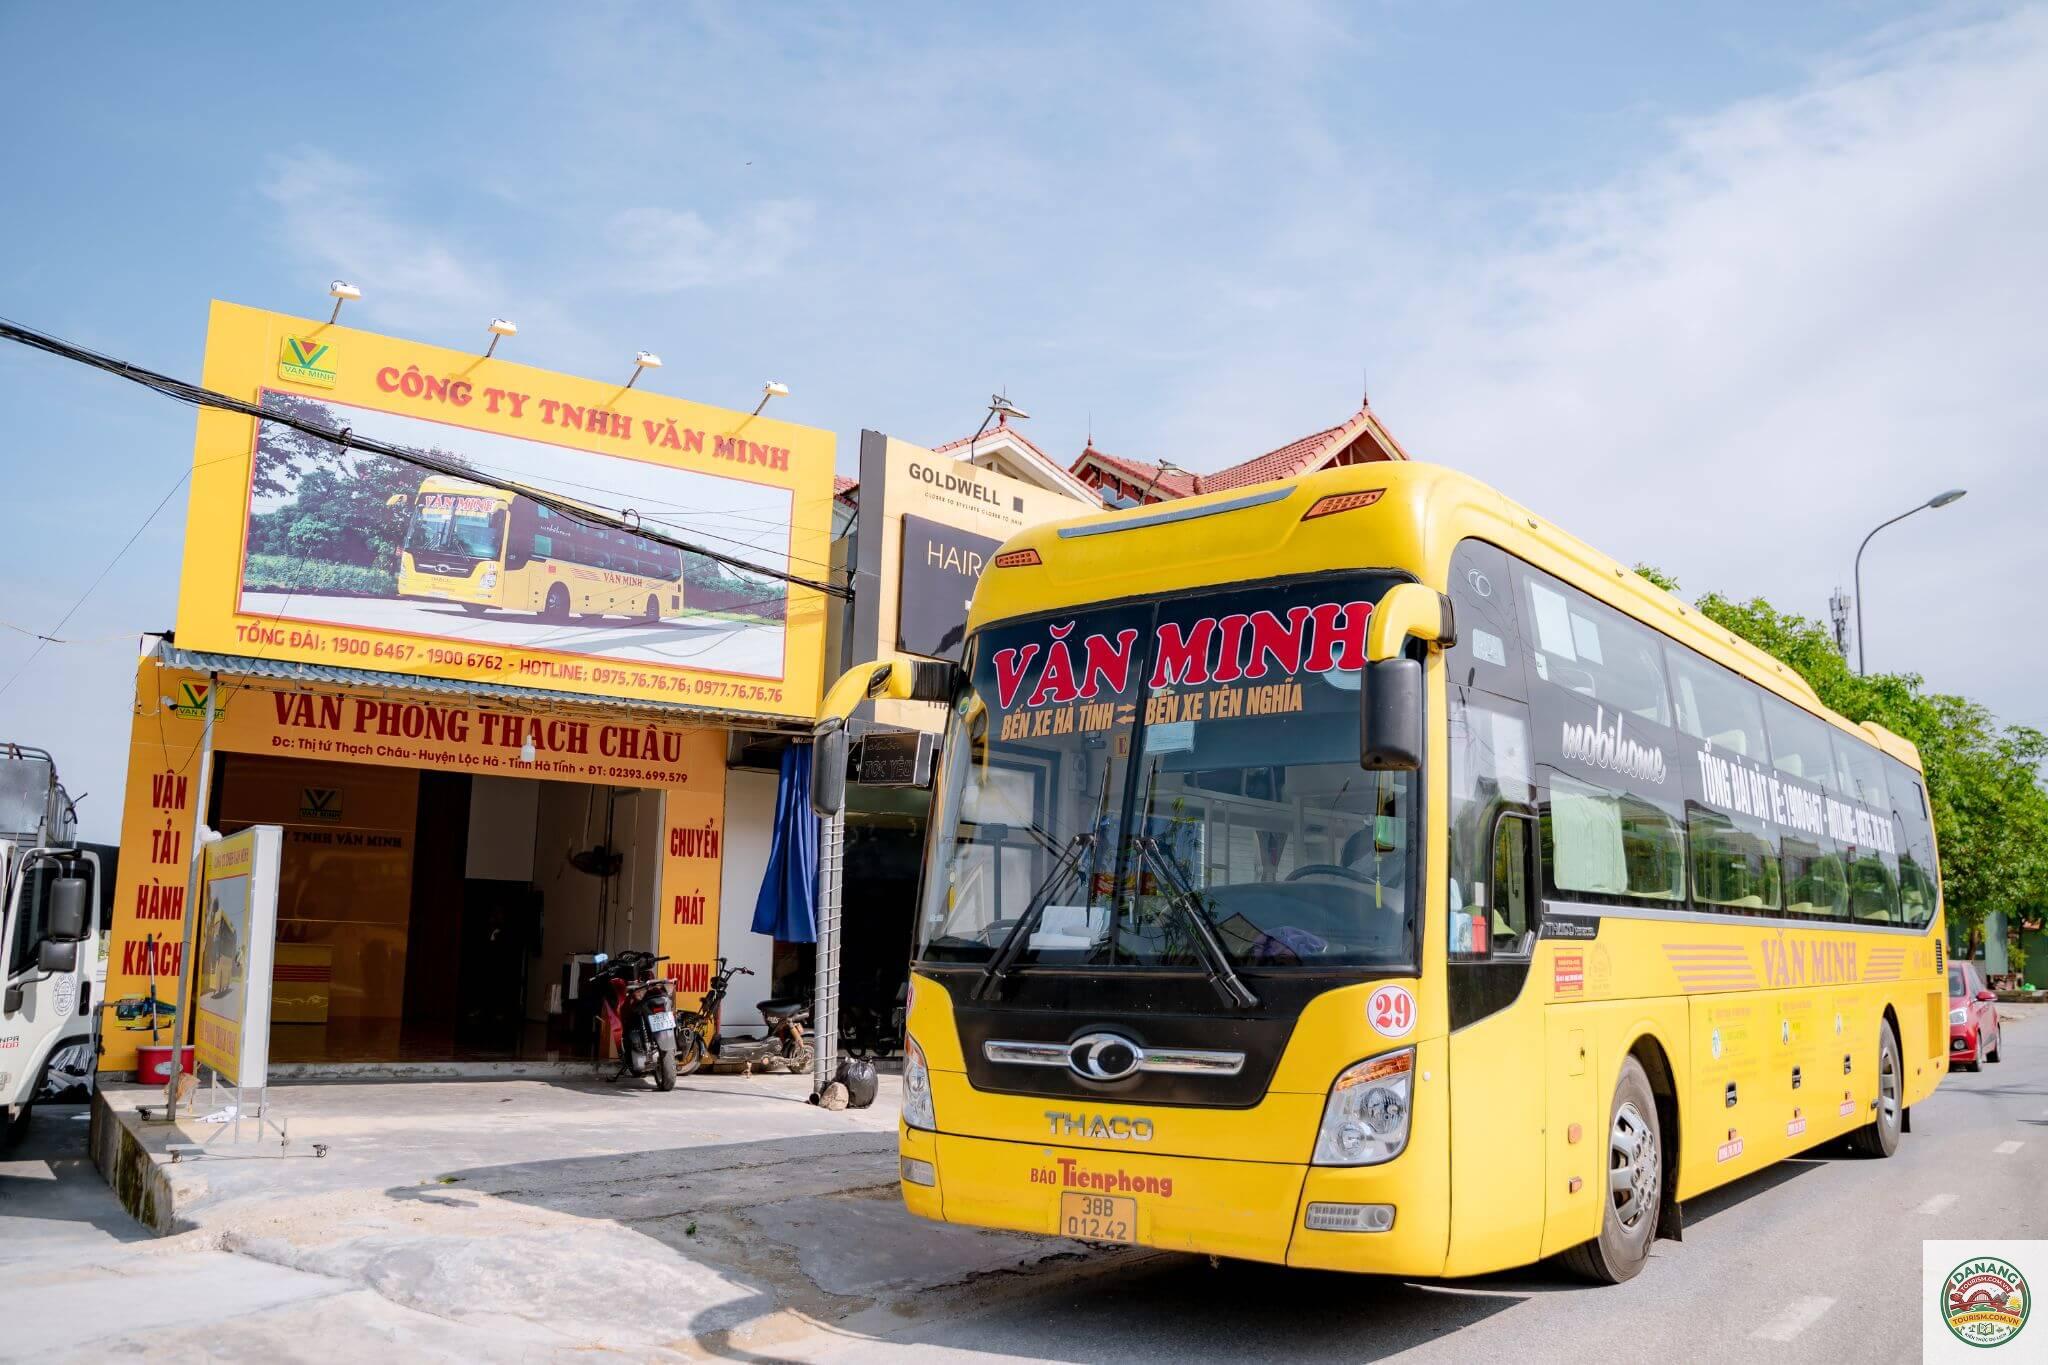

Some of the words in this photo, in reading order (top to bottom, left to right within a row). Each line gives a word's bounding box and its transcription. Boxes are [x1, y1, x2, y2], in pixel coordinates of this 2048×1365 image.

[308, 369, 335, 382] MINH
[376, 364, 473, 407] CÔNG
[483, 387, 531, 418] TY
[538, 398, 633, 440] TNHH
[642, 417, 706, 454] VĂN
[712, 434, 791, 472] MINH
[909, 462, 1000, 507] GOLDWELL
[927, 540, 983, 579] HAIR
[623, 576, 643, 588] MINH
[236, 619, 285, 646] TỔNG
[332, 636, 370, 656] 1900
[373, 641, 414, 661] 6467
[426, 648, 463, 666] 1900
[467, 653, 503, 671] 6762
[992, 620, 1139, 711] VĂN
[1149, 601, 1375, 690] MINH
[273, 686, 345, 731] VĂN
[600, 723, 683, 763] CHÂU
[1000, 704, 1031, 742] BẾN
[1032, 709, 1053, 737] XE
[1053, 702, 1074, 735] HÀ
[1078, 697, 1115, 732] TĨNH
[1144, 687, 1180, 726] BẾN
[1180, 693, 1204, 721] XE
[1208, 684, 1242, 719] YÊN
[1246, 678, 1304, 716] NGHĨA
[272, 735, 295, 748] Đc:
[298, 738, 317, 753] Thị
[318, 739, 333, 751] tứ
[335, 741, 373, 756] Thạch
[377, 745, 410, 759] Châu
[418, 749, 456, 765] Huyện
[459, 752, 480, 767] Lộc
[483, 755, 499, 767] Hà
[535, 759, 550, 772] Hà
[588, 765, 606, 777] ĐT:
[609, 766, 688, 783] 02393.699.579
[1562, 704, 1667, 784] mobihome
[152, 769, 188, 814] VẬN
[1697, 737, 1733, 809] TỔNG
[1730, 755, 1752, 814] ĐÀI
[1749, 761, 1770, 829] ĐẶT
[151, 818, 180, 864] TẢI
[670, 817, 719, 859] CHUYỂN
[136, 877, 184, 920] HÀNH
[674, 887, 706, 925] PHÁT
[122, 932, 183, 976] KHÁCH
[1811, 939, 1858, 984] MINH
[667, 963, 709, 993] NHANH
[1375, 993, 1411, 1028] 29
[1045, 1111, 1154, 1142] THACO
[1030, 1166, 1056, 1185] BÁO
[1068, 1216, 1127, 1240] 012.42
[1082, 1196, 1114, 1217] 38B
